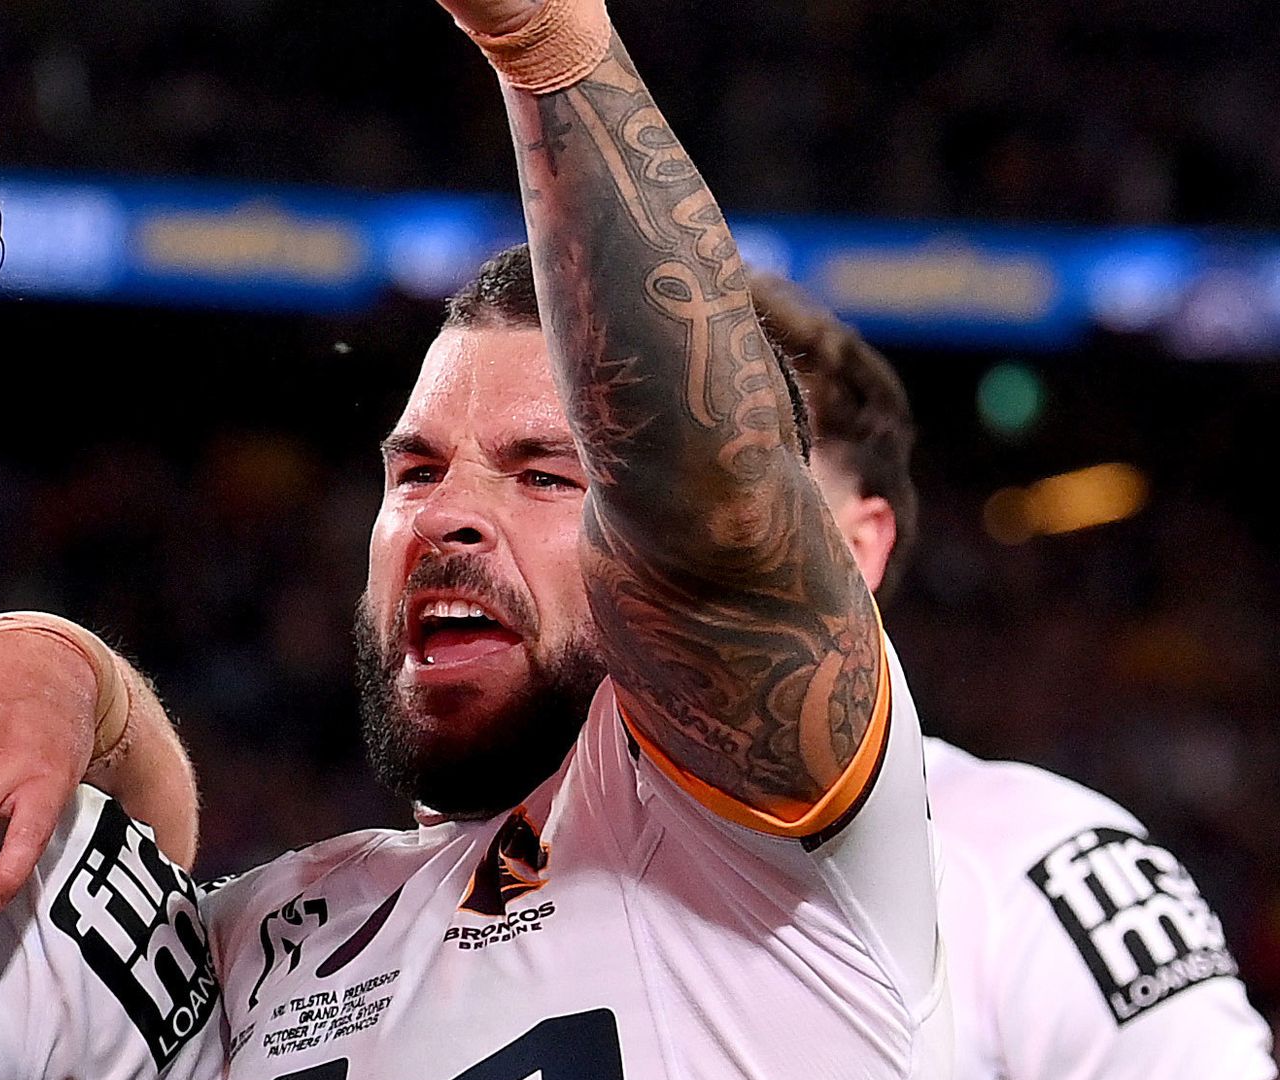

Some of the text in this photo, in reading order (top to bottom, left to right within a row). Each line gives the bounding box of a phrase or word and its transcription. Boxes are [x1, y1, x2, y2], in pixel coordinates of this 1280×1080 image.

[443, 901, 556, 942] BRONCOS
[290, 991, 338, 1013] TELSTRA
[299, 1005, 340, 1024] GRAND
[266, 1037, 320, 1058] PANTHERS
